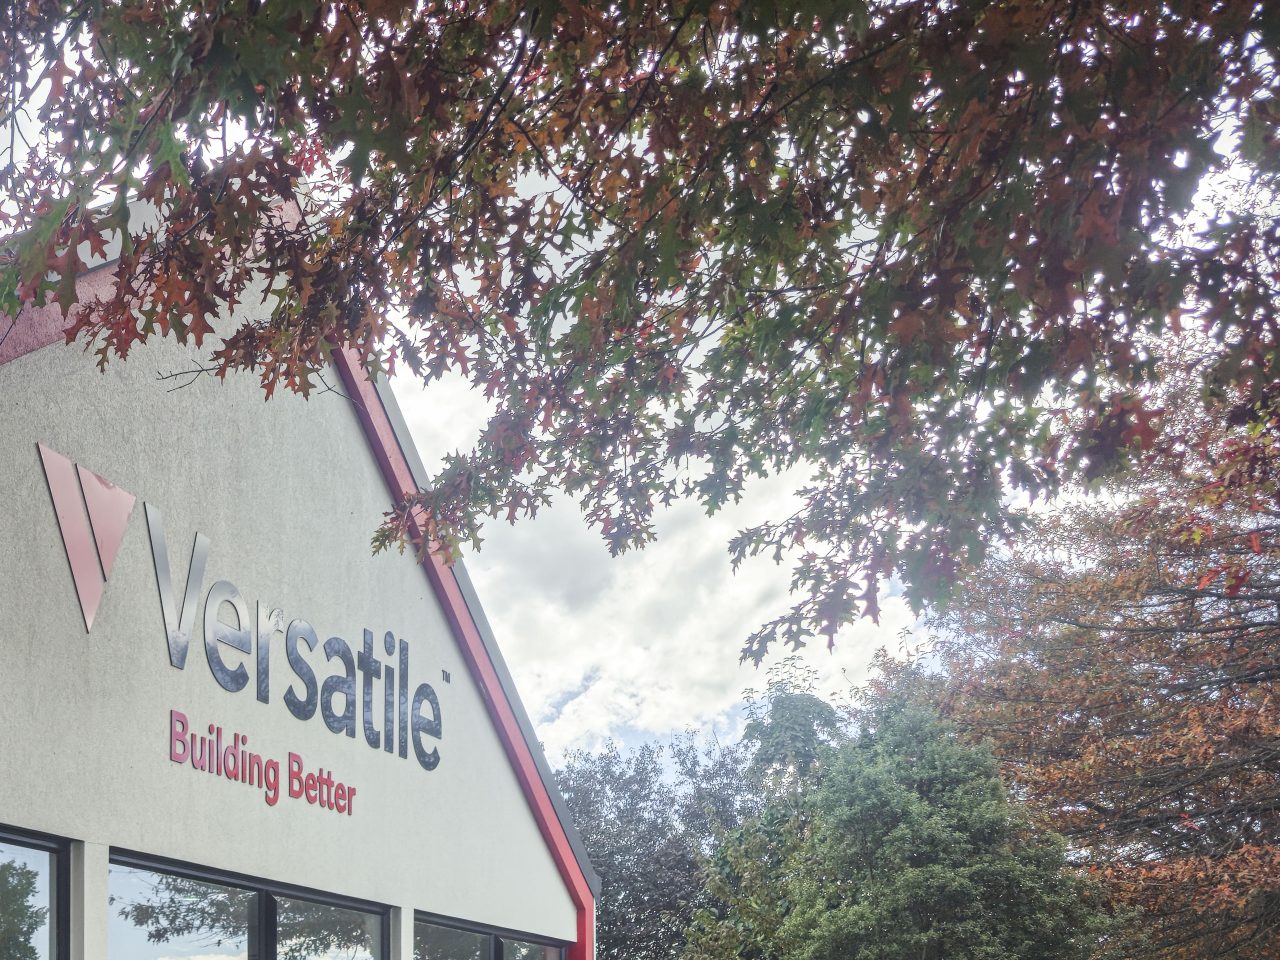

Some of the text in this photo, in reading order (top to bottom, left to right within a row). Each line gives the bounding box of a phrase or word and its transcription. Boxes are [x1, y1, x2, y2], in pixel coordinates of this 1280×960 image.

[144, 501, 443, 771] Versatile
[170, 709, 356, 816] Building Better
